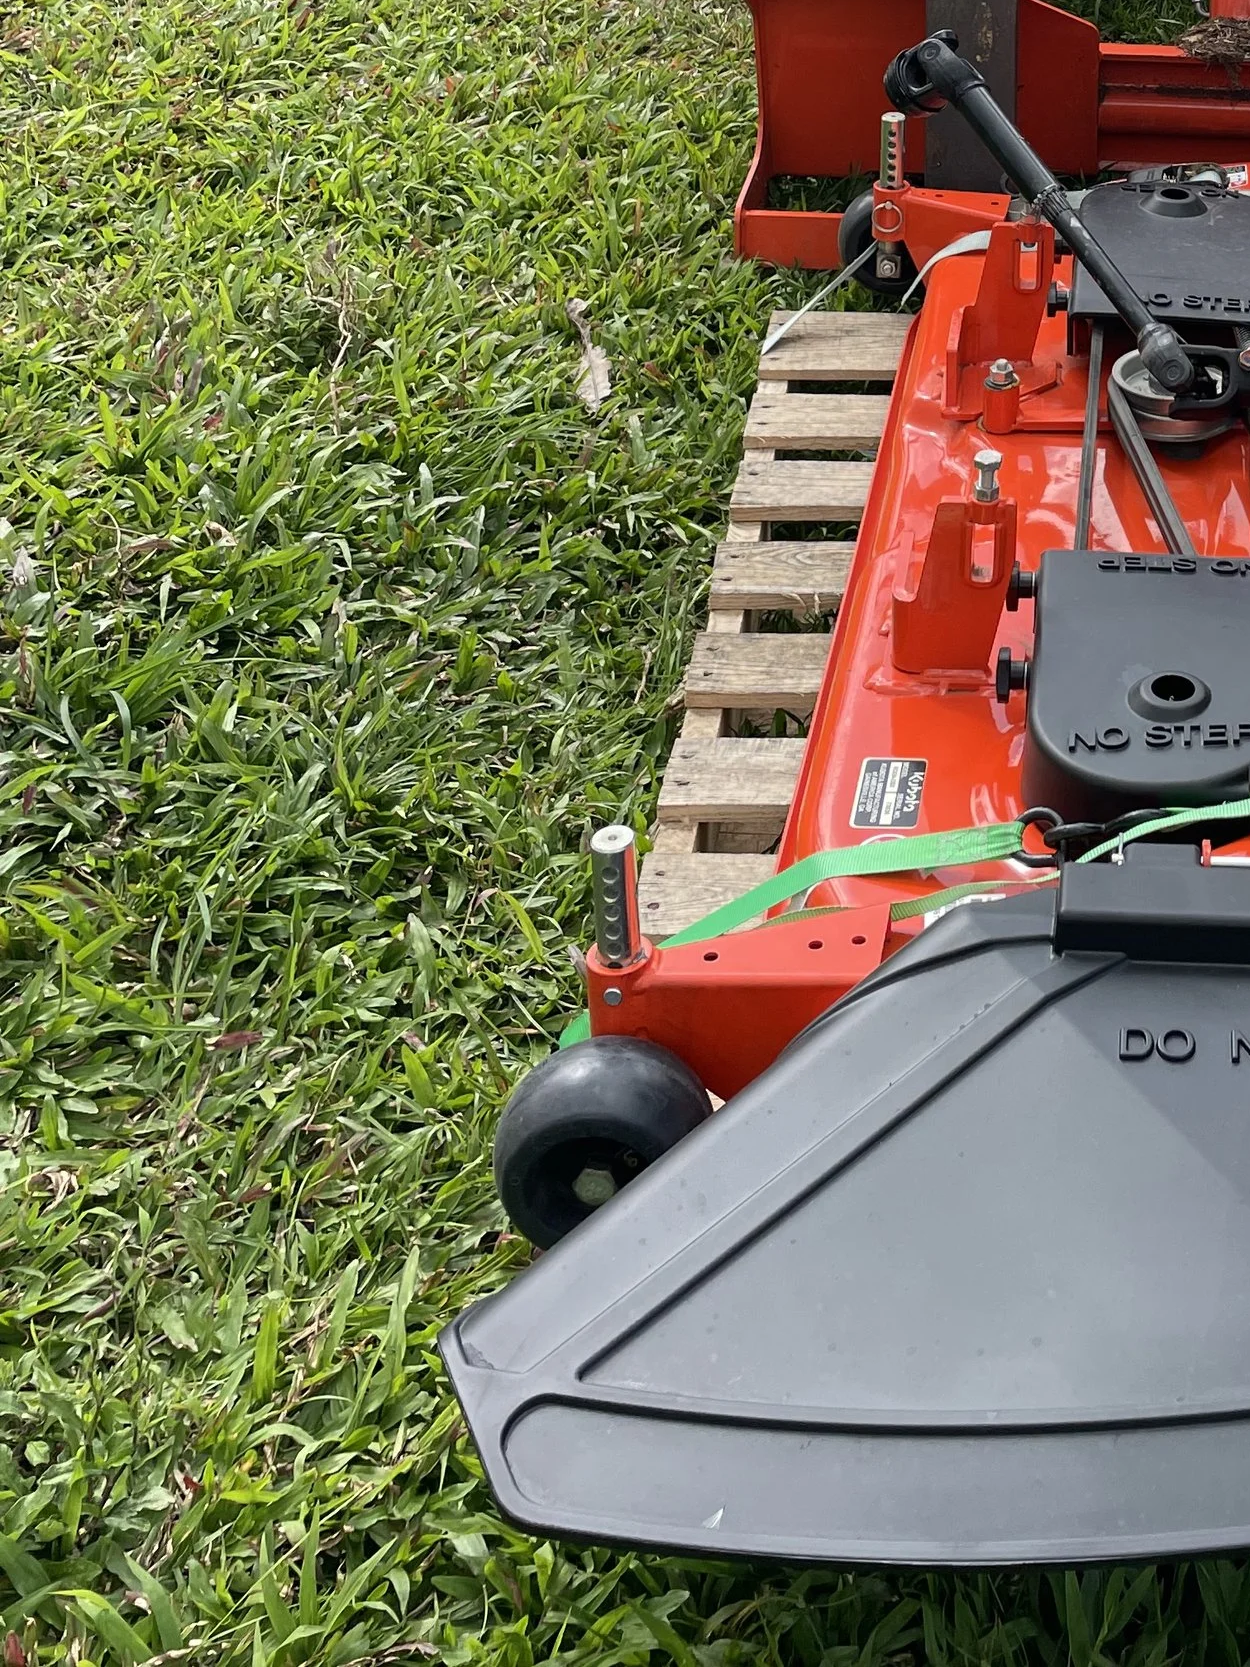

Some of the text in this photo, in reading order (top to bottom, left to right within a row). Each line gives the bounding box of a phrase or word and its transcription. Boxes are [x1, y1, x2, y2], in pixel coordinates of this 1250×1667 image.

[1098, 556, 1197, 574] STEP
[1067, 726, 1131, 753] NO
[903, 772, 925, 812] Kubota
[1118, 1027, 1196, 1063] DO
